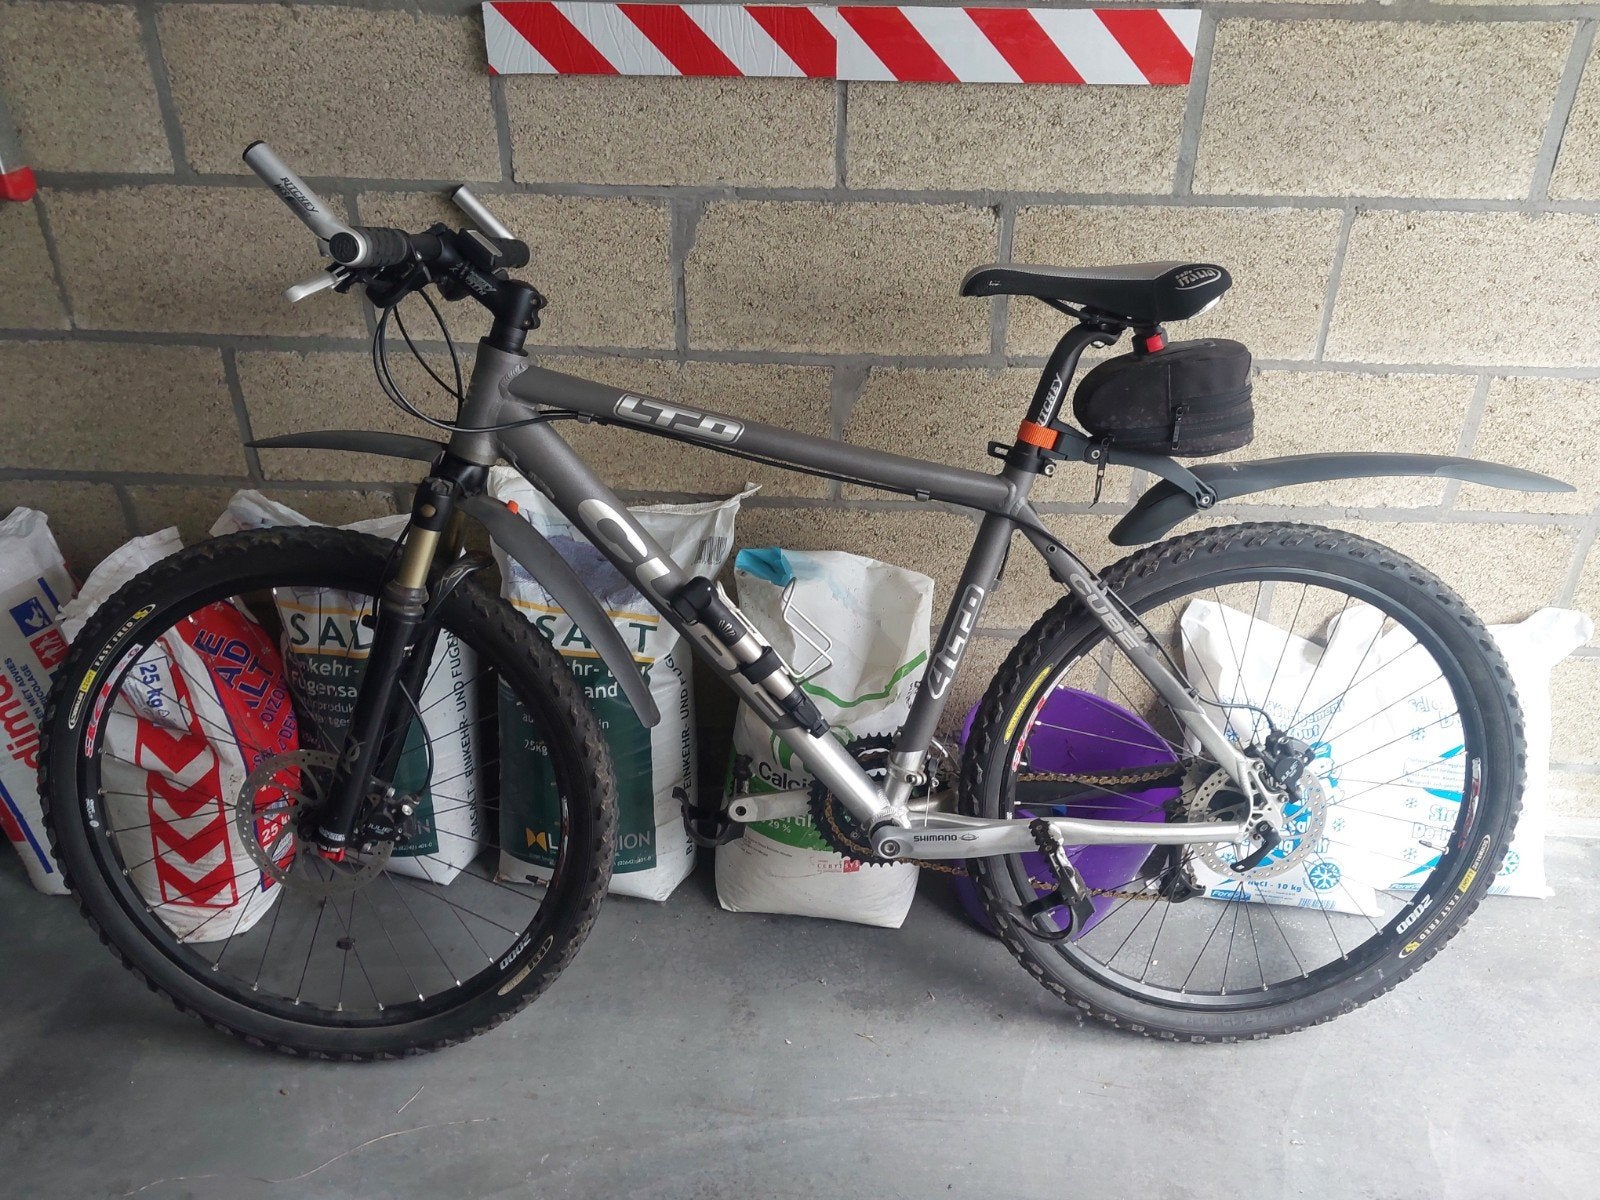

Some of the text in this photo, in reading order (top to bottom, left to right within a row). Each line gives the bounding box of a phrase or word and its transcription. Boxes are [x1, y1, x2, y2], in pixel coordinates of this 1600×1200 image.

[280, 177, 319, 213] RITCHEY
[1178, 269, 1216, 287] ITALIA
[1037, 372, 1063, 428] ITCHEY
[1069, 573, 1139, 650] CUBE
[94, 645, 113, 667] FAST
[112, 620, 134, 643] FRED
[534, 614, 658, 654] SAT
[4, 657, 27, 689] ADVIES
[140, 664, 163, 708] 25 kg
[21, 689, 39, 710] MET
[452, 686, 468, 711] UND
[680, 689, 690, 722] UND
[467, 786, 480, 839] BASALT
[262, 823, 279, 842] 25
[913, 834, 958, 842] SHIMANO
[1277, 882, 1288, 890] 10
[1290, 884, 1302, 893] kg
[1395, 893, 1434, 936] 2000
[1440, 893, 1460, 917] FAST
[1419, 917, 1441, 940] FRED
